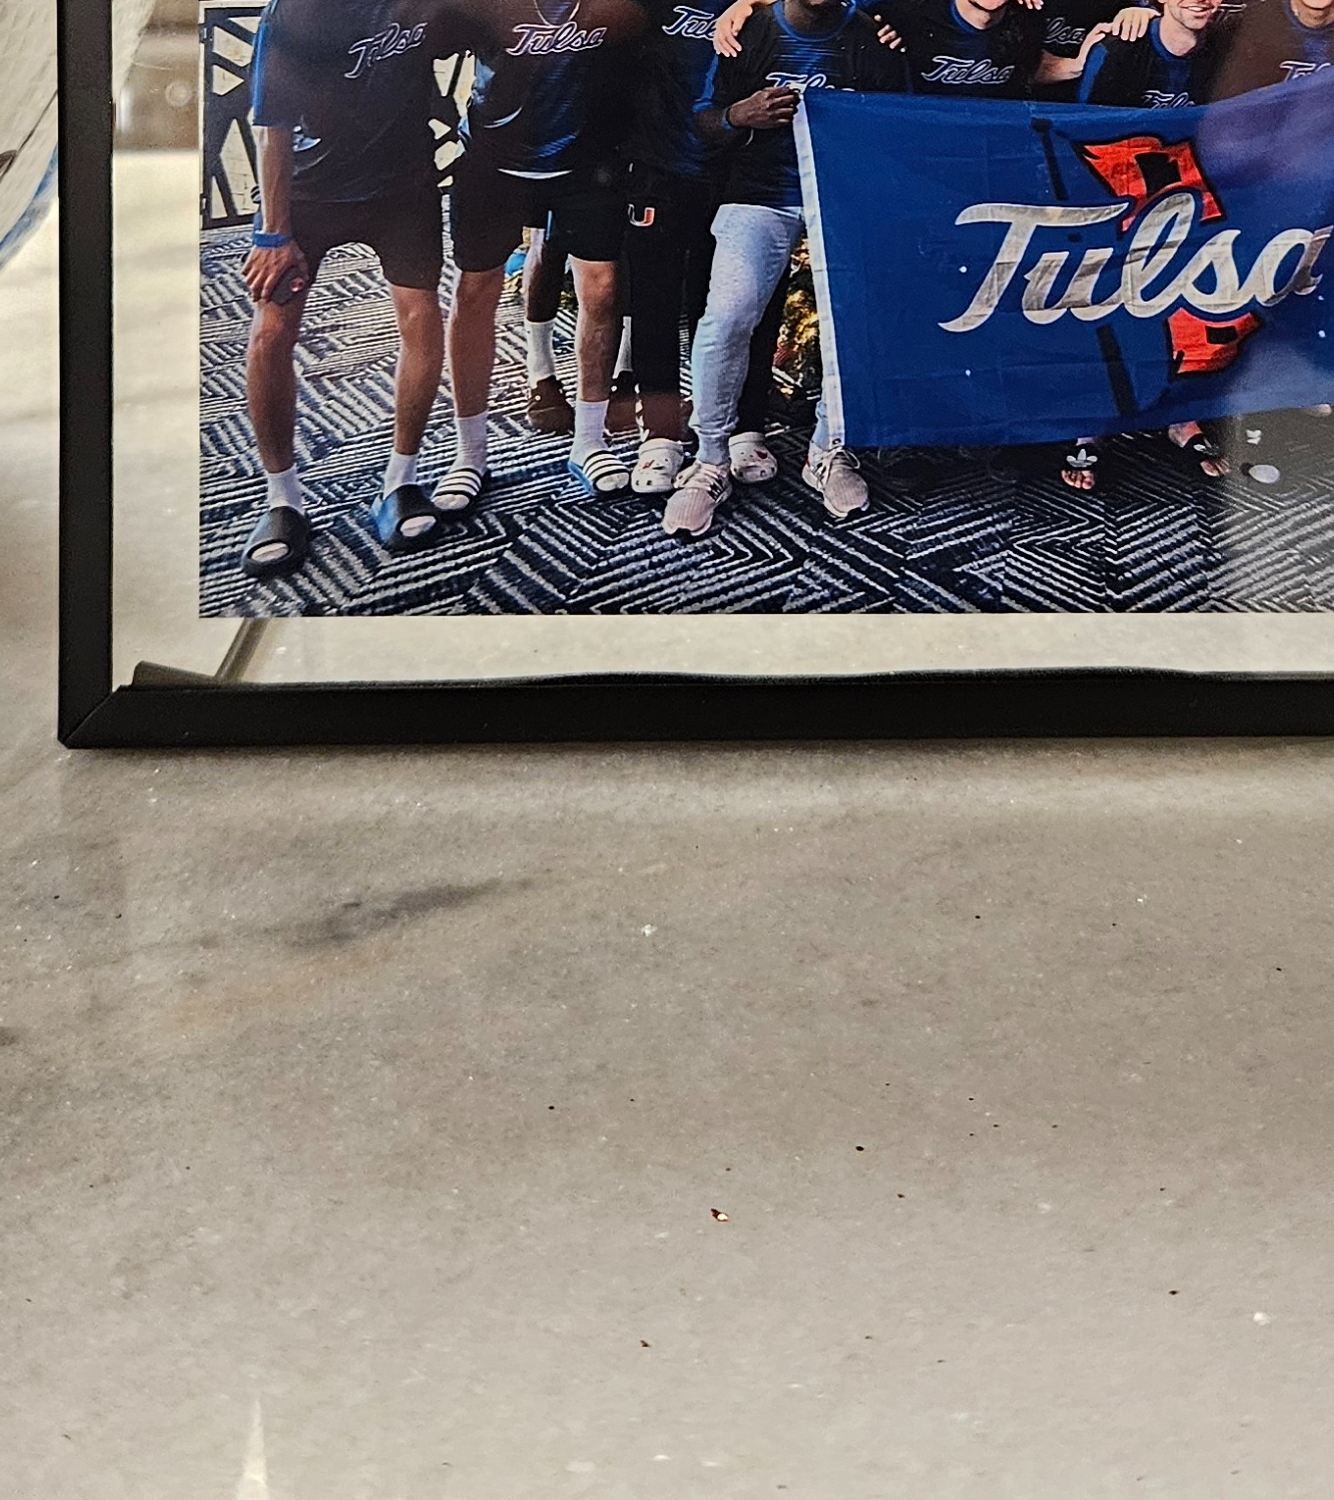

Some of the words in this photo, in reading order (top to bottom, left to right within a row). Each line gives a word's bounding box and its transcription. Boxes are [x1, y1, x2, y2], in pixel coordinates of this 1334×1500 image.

[506, 20, 607, 56] Tulsa
[921, 55, 1015, 85] Tulsa
[938, 192, 1334, 333] Tulsa
